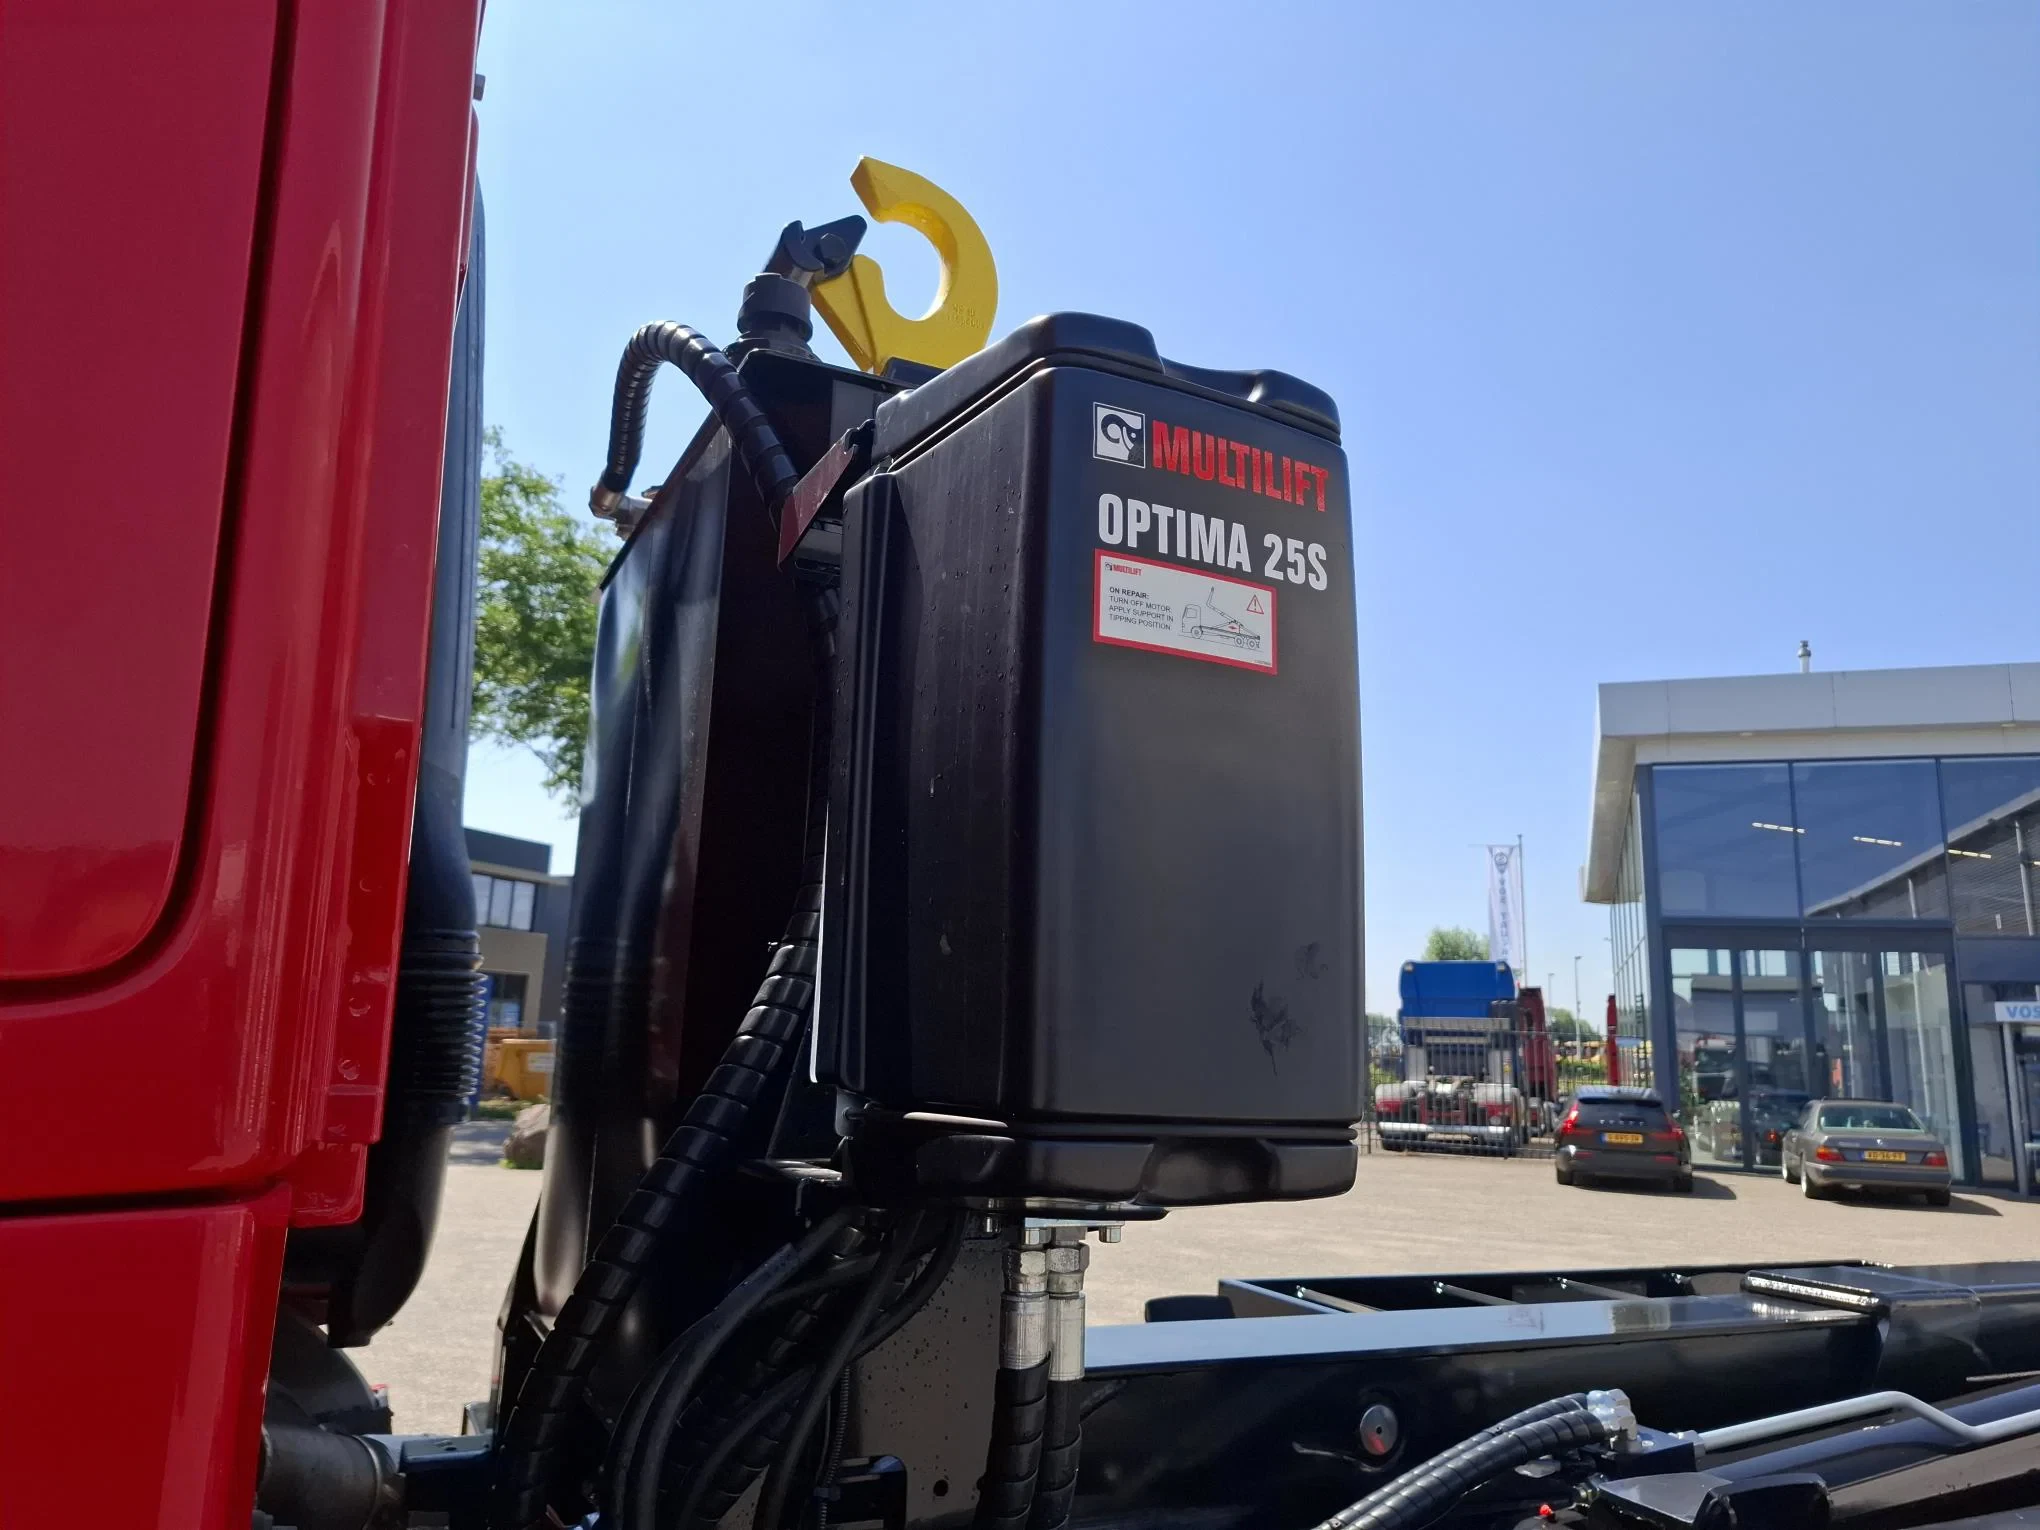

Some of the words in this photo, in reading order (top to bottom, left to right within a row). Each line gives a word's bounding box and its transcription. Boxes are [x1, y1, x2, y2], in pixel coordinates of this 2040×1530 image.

[1152, 419, 1329, 512] MULTILIFT
[1098, 493, 1252, 573] OPTIMA
[1263, 533, 1328, 591] 25S
[1113, 565, 1141, 575] MULTILIFT
[1109, 586, 1120, 594] ON
[1121, 588, 1150, 599] REPAIR:
[1109, 596, 1129, 605] TURN
[1130, 599, 1144, 607] OFF
[1109, 605, 1131, 614] APPLY
[1132, 609, 1165, 619] SUPPORT
[1109, 614, 1137, 624] TIPPING
[1138, 619, 1171, 630] POSITION
